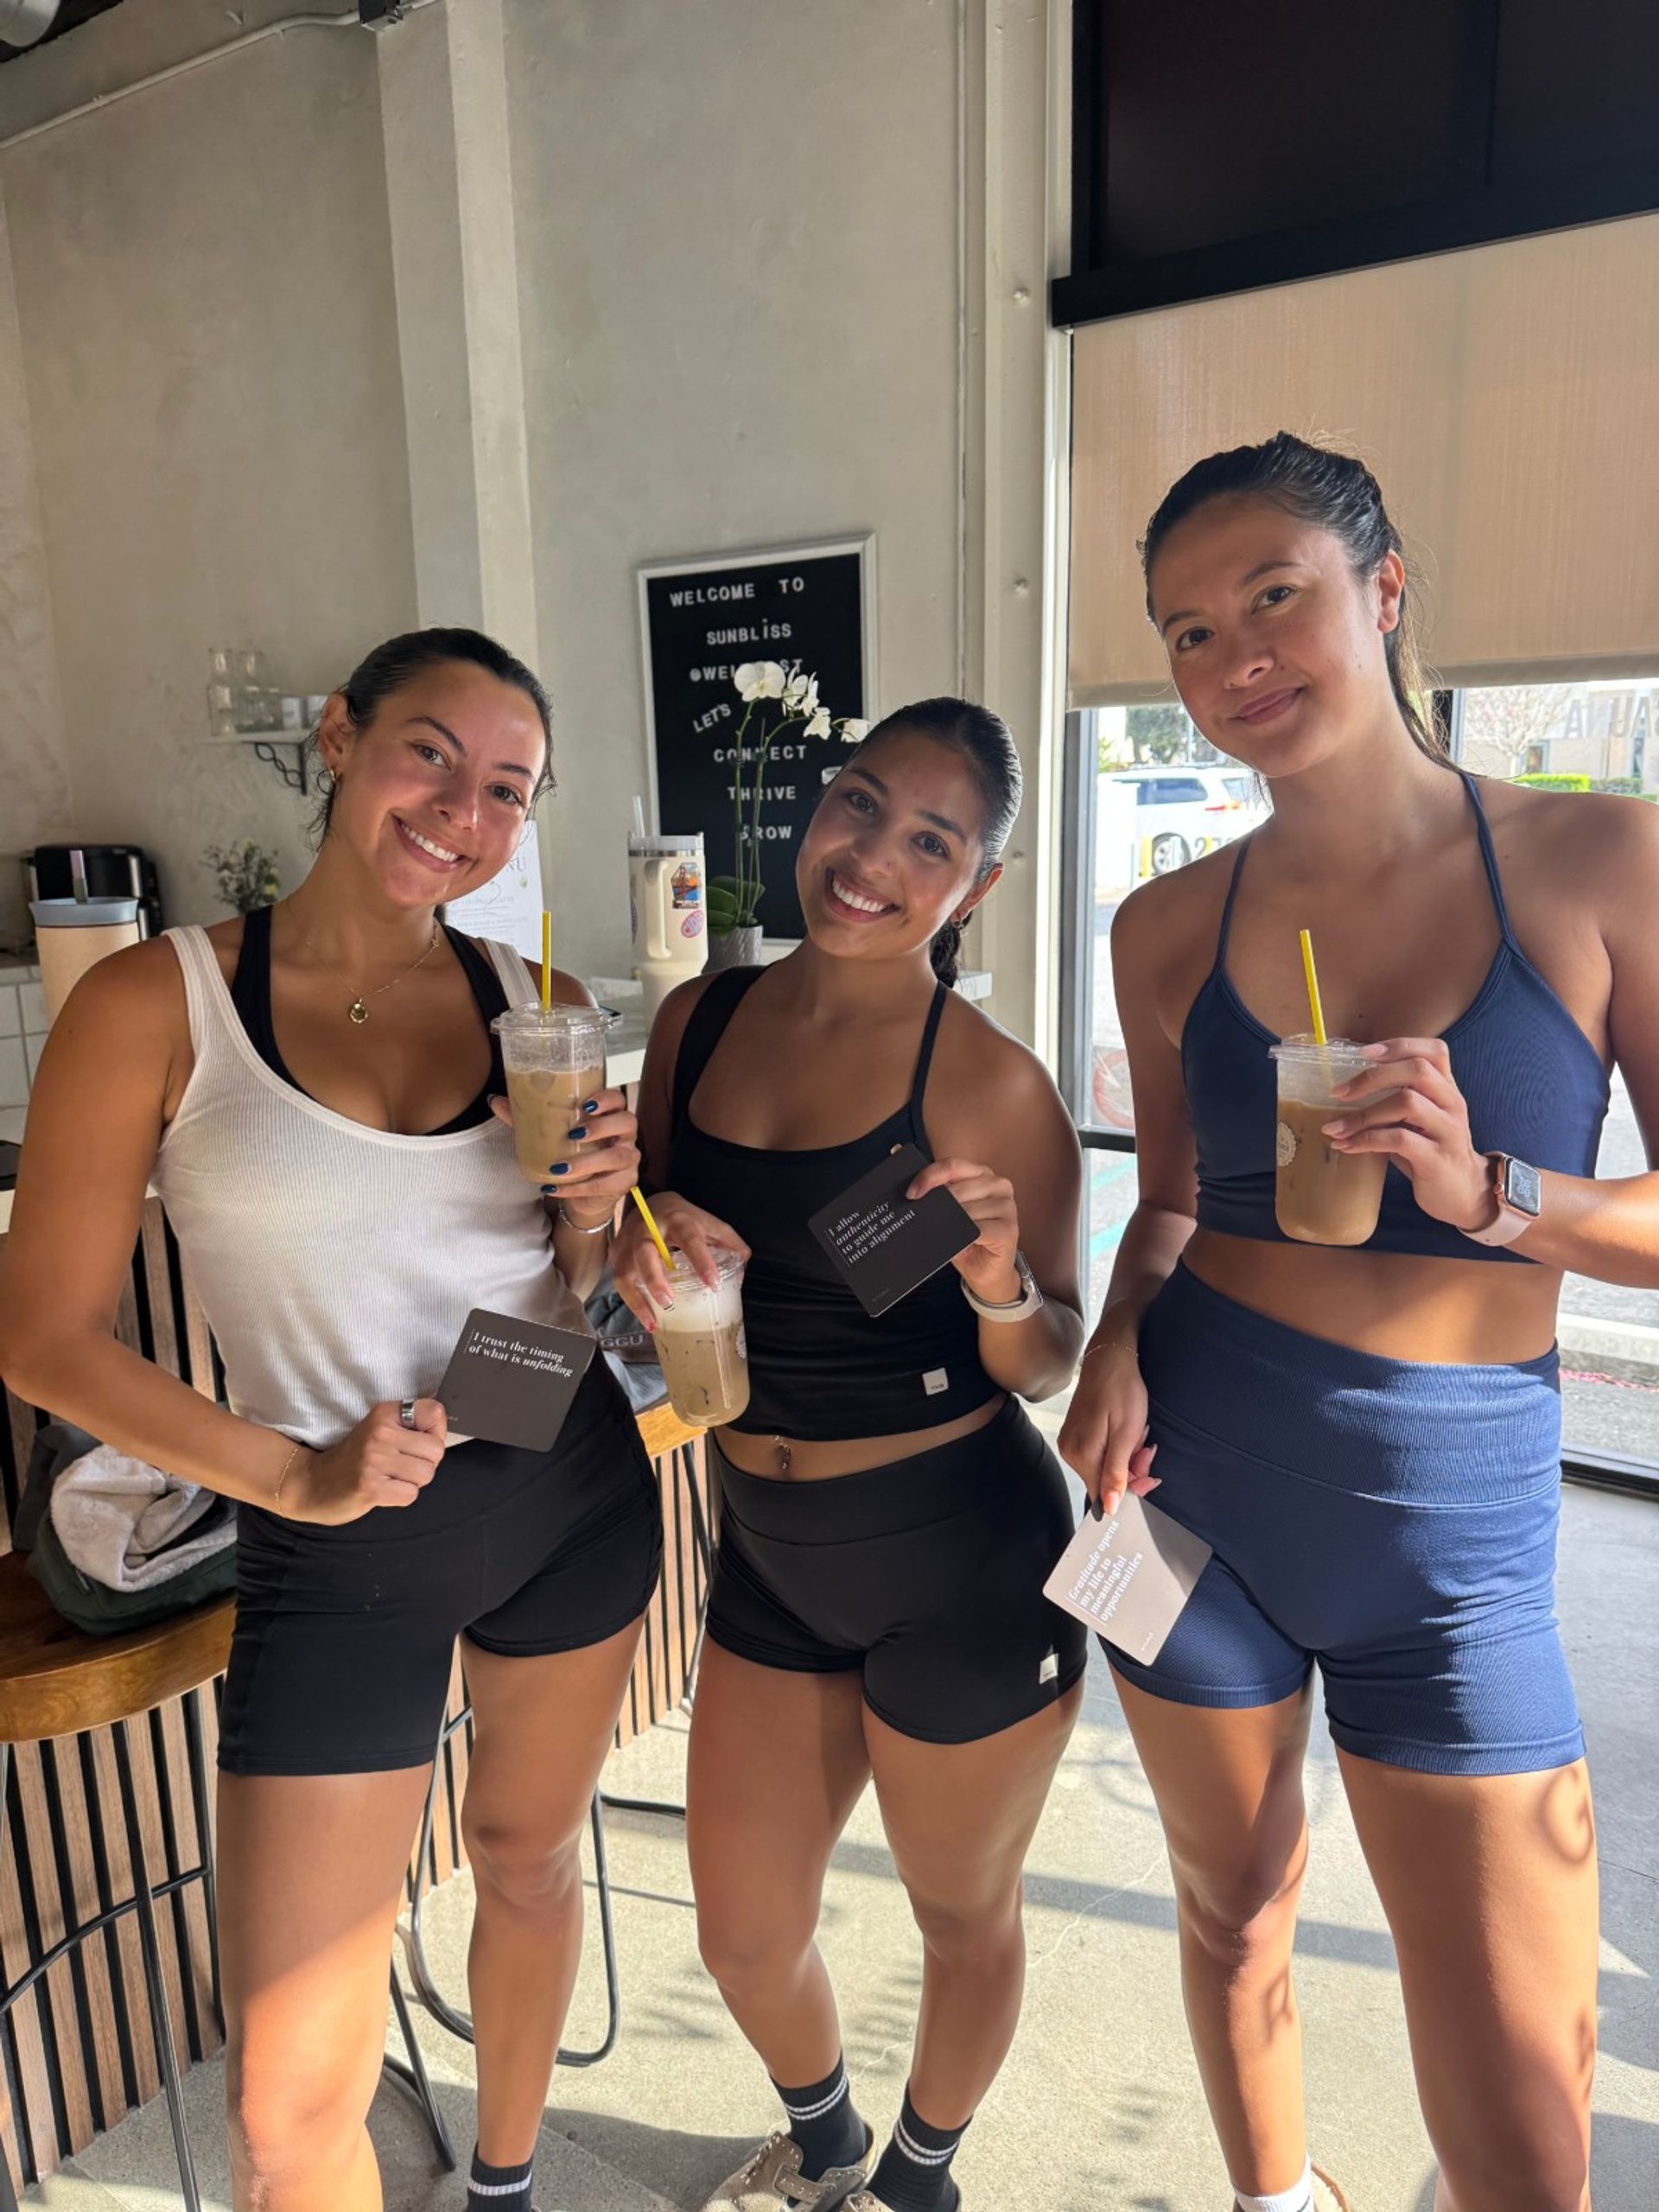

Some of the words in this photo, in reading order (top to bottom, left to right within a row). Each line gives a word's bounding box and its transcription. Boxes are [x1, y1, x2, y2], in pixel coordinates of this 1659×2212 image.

[670, 582, 755, 607] WELCOME
[779, 576, 804, 594] TO
[693, 702, 732, 733] LET'S
[727, 785, 797, 801] THRIVE
[830, 1228, 835, 1236] I
[836, 1211, 860, 1231] allow
[836, 1201, 889, 1245] authenticity
[842, 1243, 853, 1255] to
[854, 1224, 879, 1248] guide
[880, 1211, 895, 1225] me
[848, 1246, 868, 1263] into
[868, 1210, 916, 1249] alignment
[468, 1344, 483, 1354] of
[484, 1348, 509, 1361] what
[511, 1353, 521, 1363] is
[522, 1357, 574, 1378] unfolding
[474, 1332, 480, 1341] I
[480, 1335, 508, 1348] trust
[510, 1341, 528, 1353] the
[529, 1346, 564, 1363] timing
[1068, 1551, 1101, 1600] Gratitude
[1097, 1520, 1121, 1552] opens
[1079, 1589, 1096, 1608] my
[1088, 1570, 1105, 1589] life
[1100, 1558, 1112, 1571] to
[1090, 1554, 1128, 1614] meaningful
[1100, 1551, 1144, 1622] opportunities
